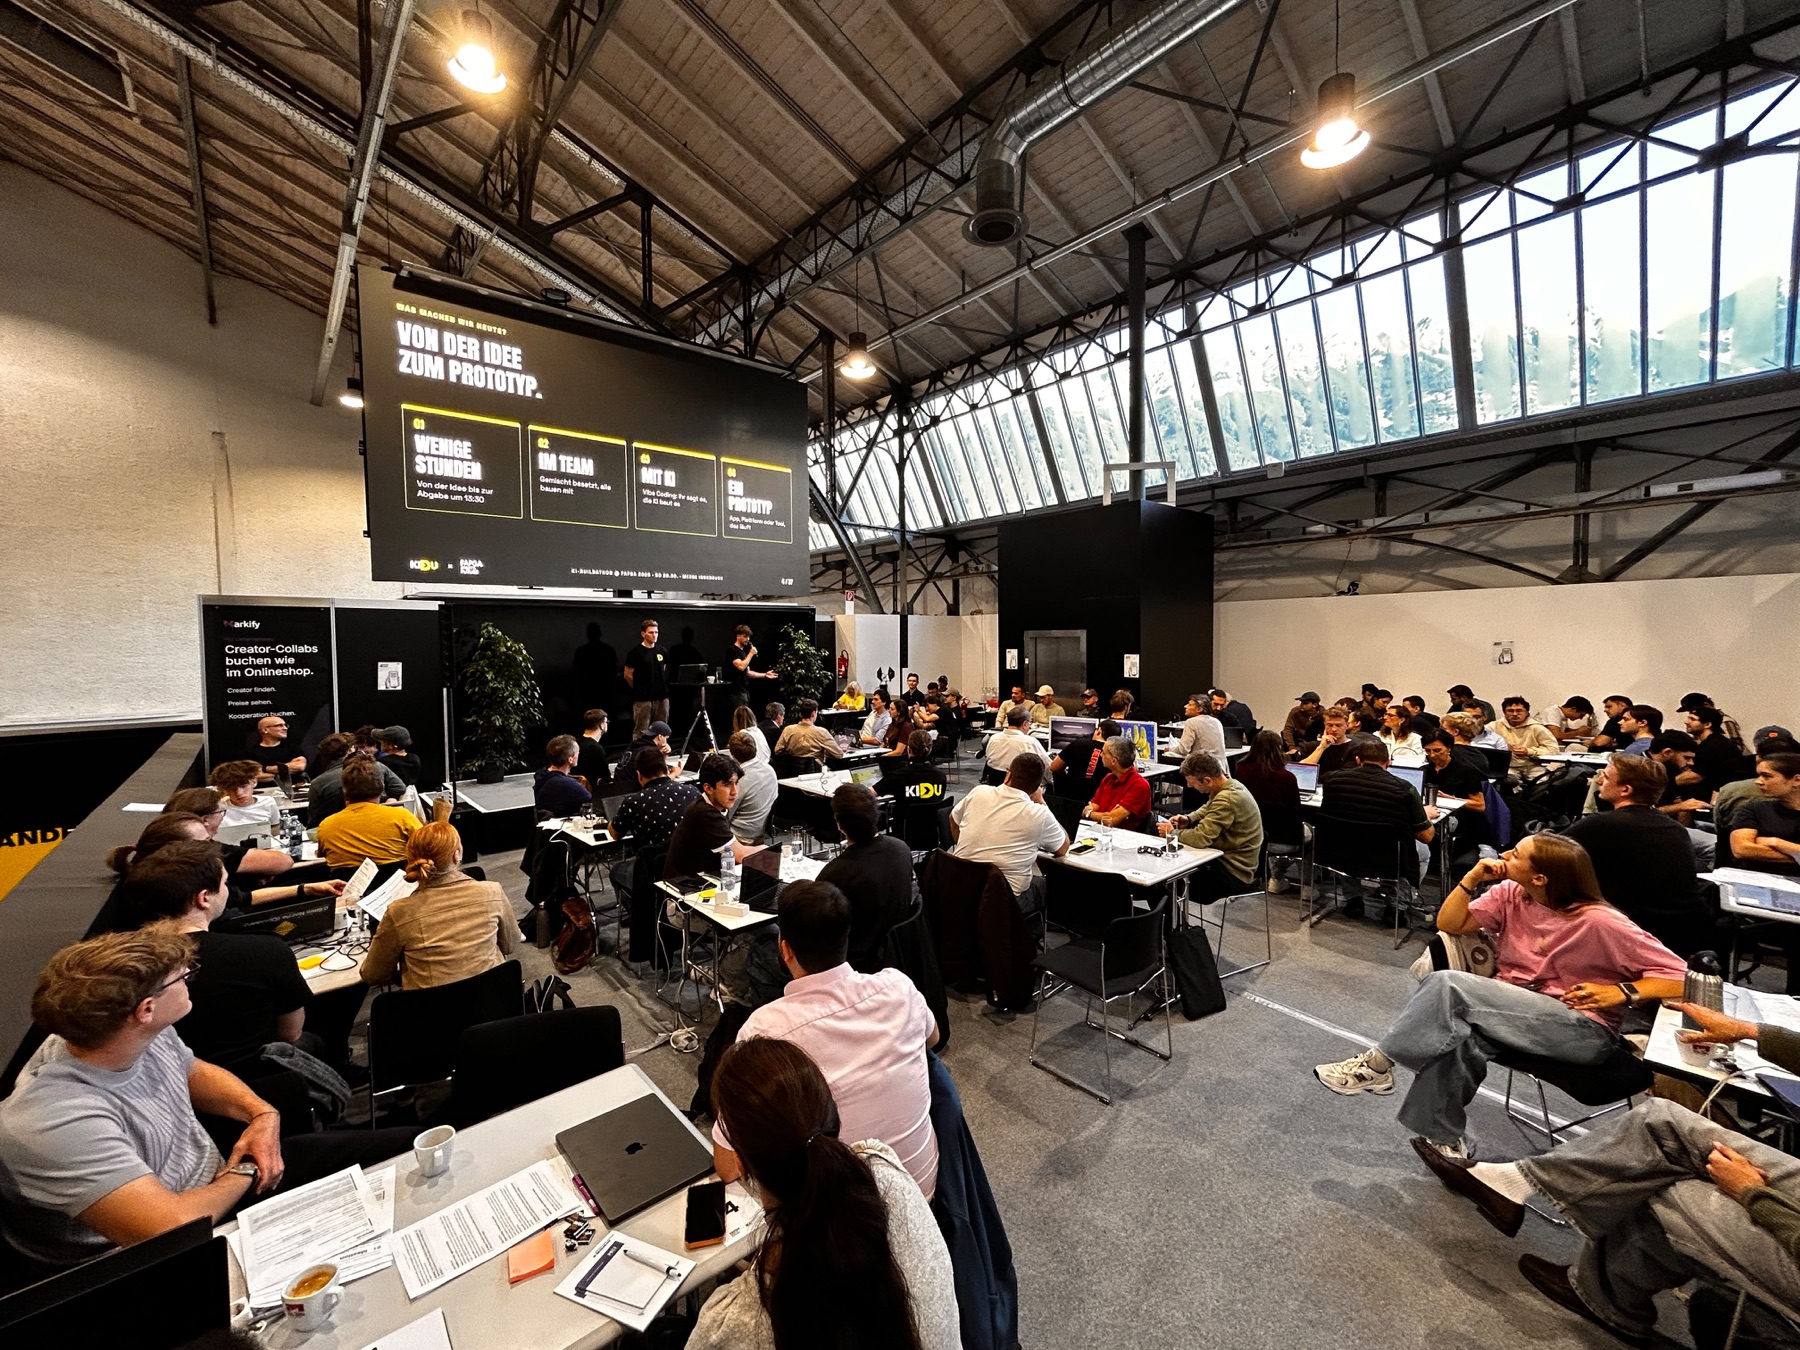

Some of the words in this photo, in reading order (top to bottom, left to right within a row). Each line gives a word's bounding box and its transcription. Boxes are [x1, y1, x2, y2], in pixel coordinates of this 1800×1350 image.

[396, 303, 416, 314] WAS
[419, 308, 455, 323] MACHEN
[458, 318, 474, 328] WIR
[476, 322, 507, 336] HEUTE?
[397, 321, 439, 352] VON
[443, 331, 480, 361] DER
[483, 340, 522, 370] IDEE
[398, 349, 444, 380] ZUM
[448, 359, 543, 399] PROTOTYP.
[413, 418, 425, 430] 01
[414, 434, 472, 459] WENIGE
[415, 454, 482, 480] STUNDEN
[538, 451, 557, 471] IM
[559, 454, 594, 476] TEAM
[539, 475, 572, 486] Gemischt
[641, 466, 663, 485] MIT
[416, 480, 433, 489] Von
[434, 481, 448, 490] der
[449, 483, 467, 492] Idee
[468, 485, 480, 494] bis
[540, 484, 561, 493] bauen
[562, 487, 574, 495] mit
[416, 489, 449, 500] Abgabe
[464, 494, 485, 503] 13:30
[728, 495, 773, 515] PROTOTYP
[409, 559, 439, 571] KIDU
[225, 644, 319, 654] Creator-Collabs
[225, 656, 271, 666] buchen
[274, 655, 295, 665] wie
[226, 668, 241, 677] im
[244, 666, 314, 677] Onlineshop.
[228, 712, 269, 720] Kooperation
[905, 782, 942, 799] KIDU
[0, 827, 72, 848] AND
